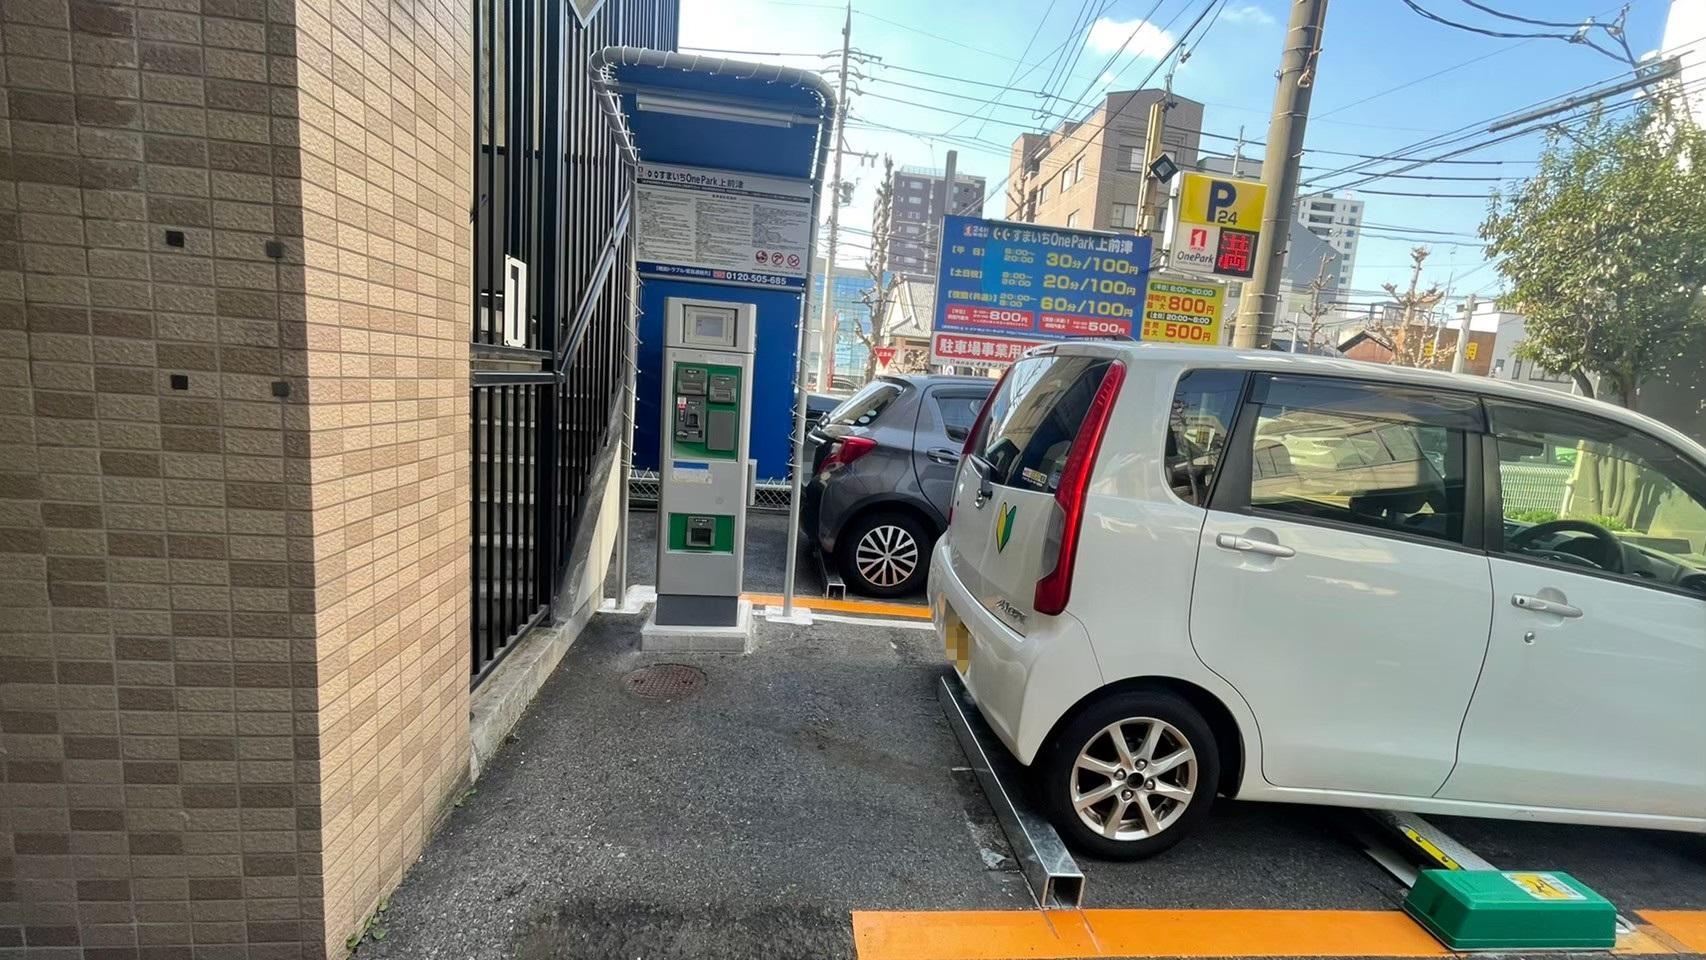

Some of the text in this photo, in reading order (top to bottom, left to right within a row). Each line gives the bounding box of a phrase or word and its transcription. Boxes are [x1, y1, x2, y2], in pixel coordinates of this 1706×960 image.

[1207, 181, 1238, 225] P 24
[1013, 230, 1134, 254] すまいちOnePark 上前津
[1177, 251, 1215, 265] OnePark
[726, 271, 787, 286] 0120-505-685
[1168, 296, 1215, 316] 800円
[1164, 323, 1211, 342] 500円
